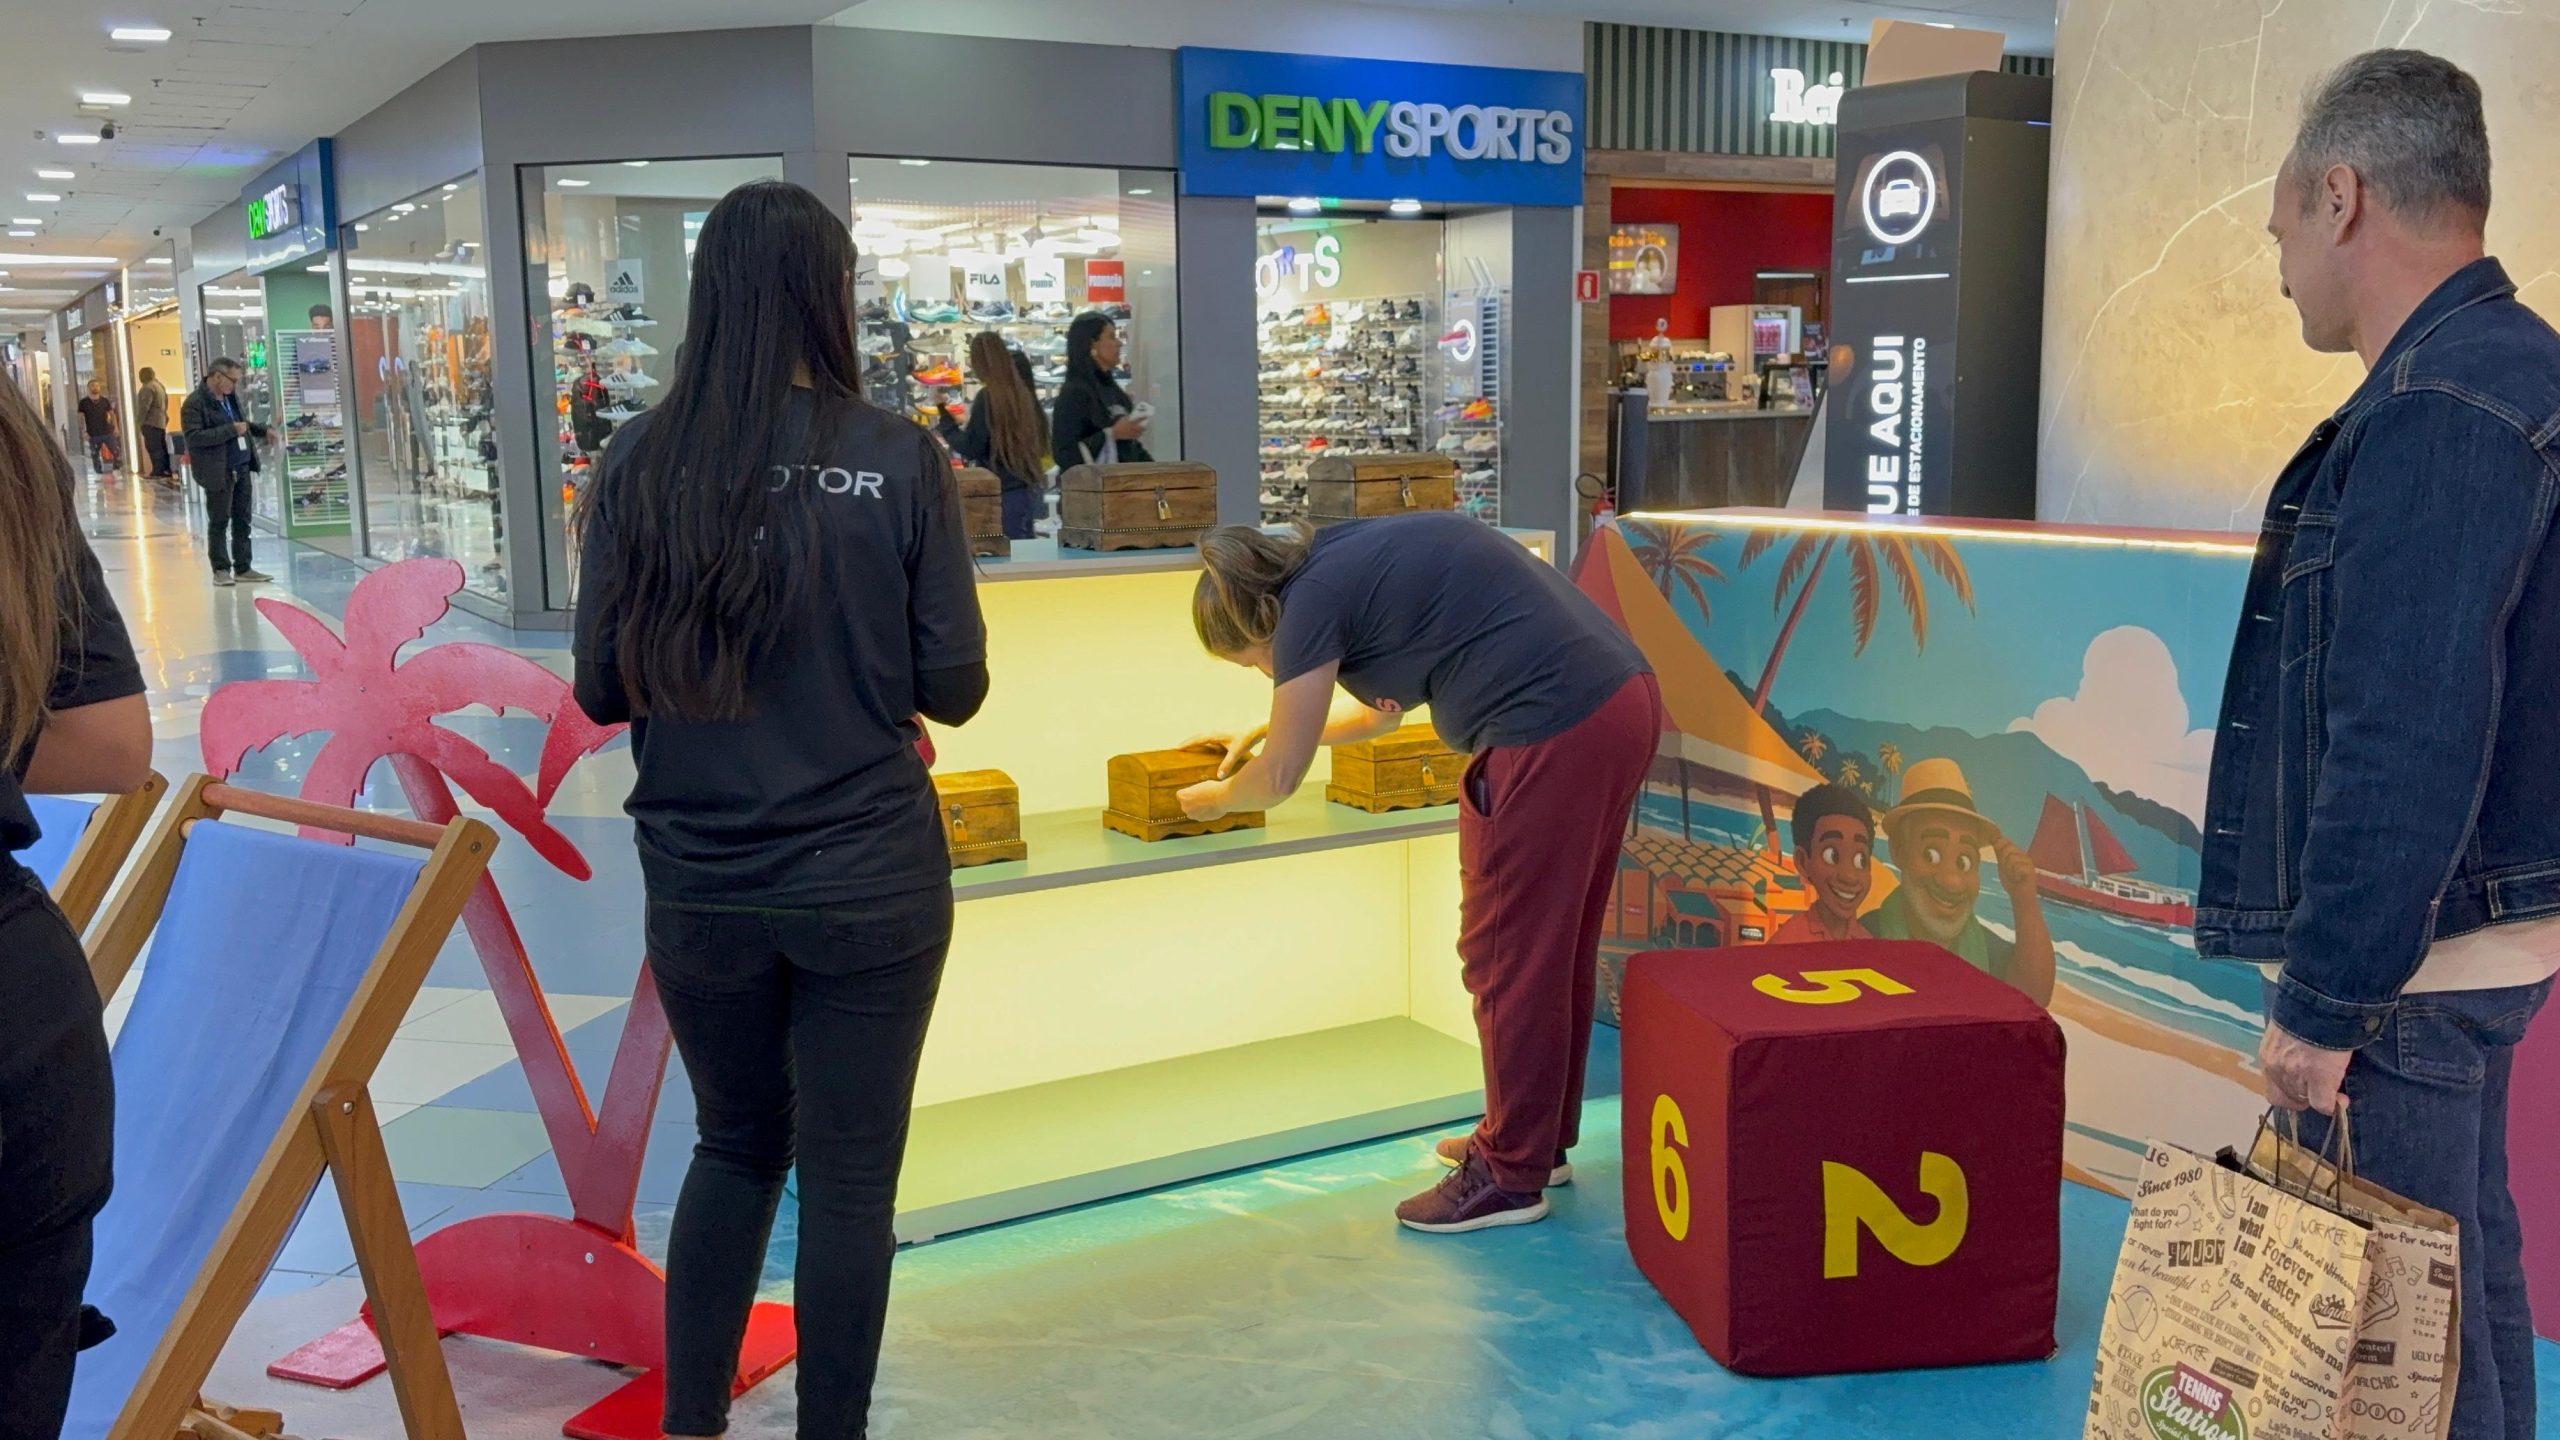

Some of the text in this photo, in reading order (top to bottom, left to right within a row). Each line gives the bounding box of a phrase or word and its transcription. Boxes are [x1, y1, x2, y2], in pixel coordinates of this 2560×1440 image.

[970, 274, 1000, 284] FILA
[1030, 280, 1053, 288] PUMA
[1870, 335, 1904, 447] AQUI
[1908, 337, 1926, 482] ESTACIONAMENTO
[1752, 968, 1917, 1004] 5
[2137, 1167, 2203, 1198] Since 1980
[1822, 1151, 1969, 1279] 2
[2150, 1207, 2161, 1217] do
[2163, 1209, 2179, 1219] you
[2251, 1200, 2269, 1219] am
[2133, 1218, 2172, 1231] fight for?
[2238, 1216, 2265, 1239] what
[2137, 1242, 2165, 1259] never
[2167, 1239, 2225, 1267] ENJOY
[2238, 1240, 2256, 1259] am
[2399, 1231, 2417, 1244] for
[2419, 1237, 2453, 1256] every
[2261, 1236, 2314, 1287] Forever
[2151, 1264, 2197, 1292] beautiful
[2258, 1263, 2301, 1307] Faster
[2230, 1272, 2245, 1289] the
[2244, 1285, 2263, 1304] real
[2260, 1297, 2302, 1339] skateboard
[2301, 1333, 2326, 1360] shoes
[2411, 1350, 2433, 1361] UGLY
[2178, 1371, 2224, 1411] TENNIS
[2279, 1386, 2290, 1399] do
[2290, 1395, 2308, 1409] you
[2281, 1401, 2299, 1417] for?
